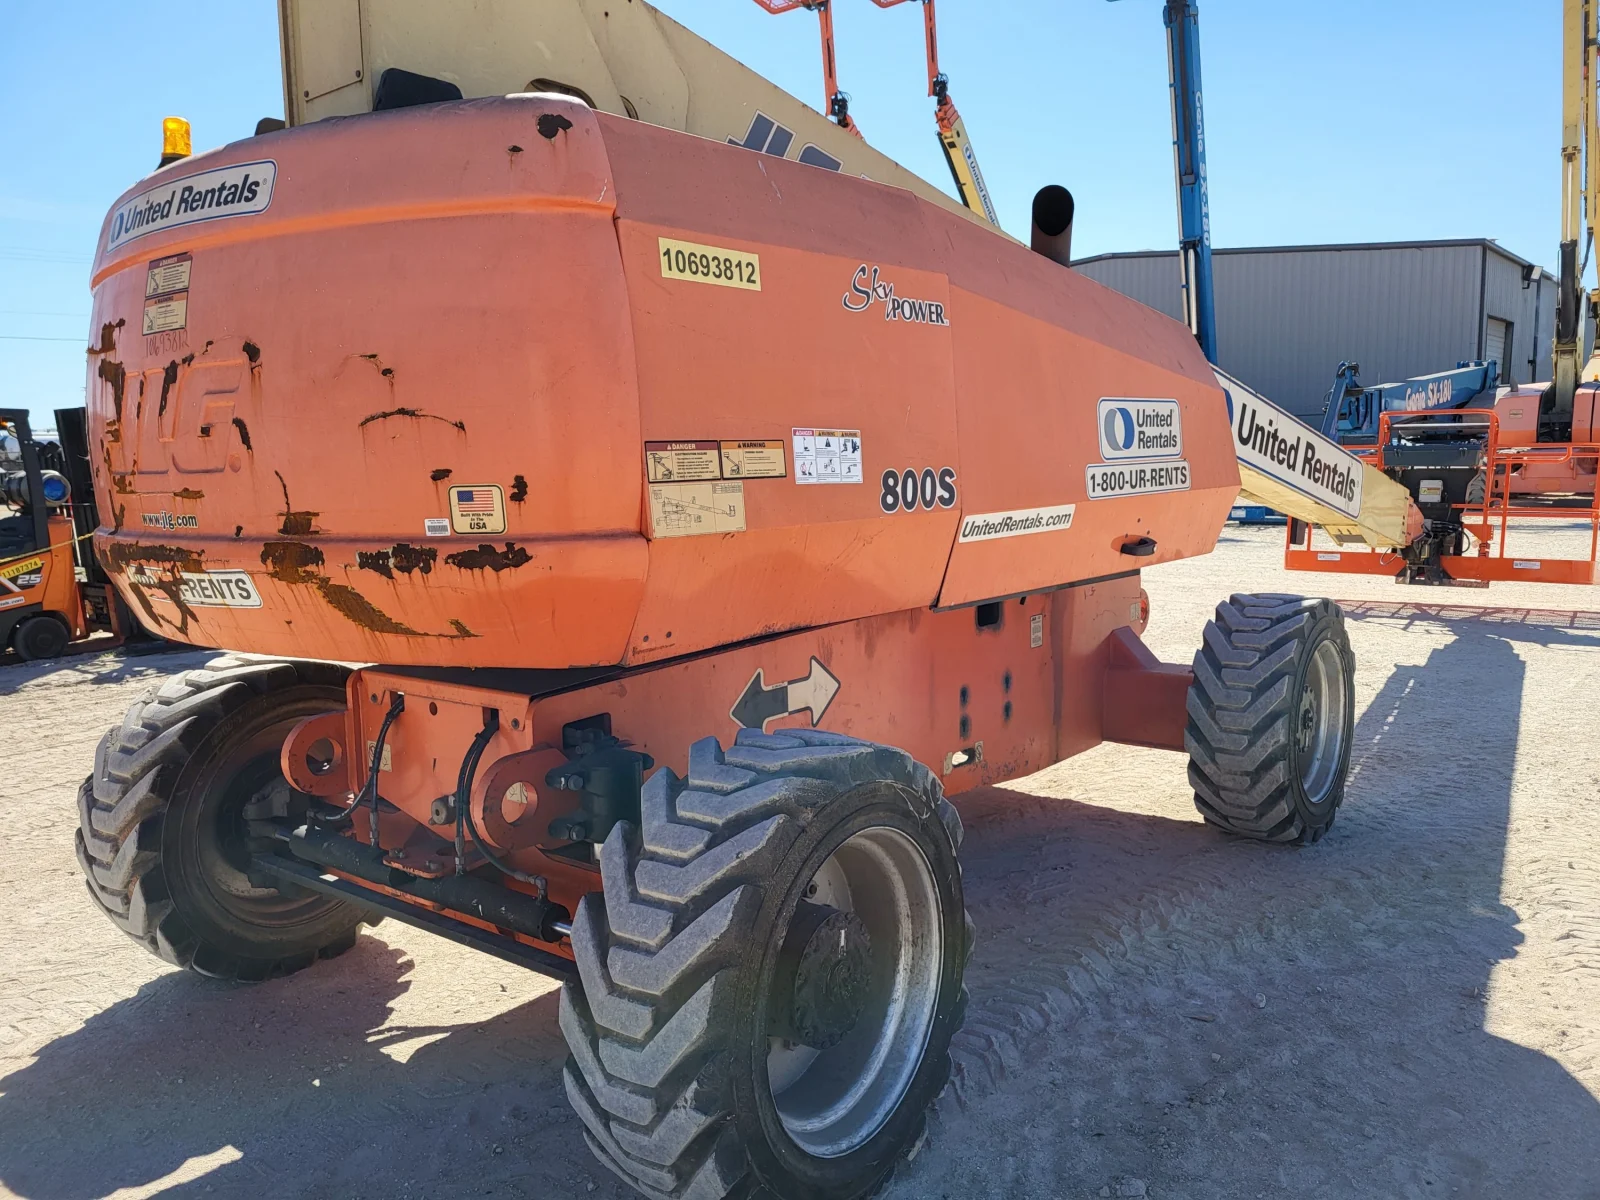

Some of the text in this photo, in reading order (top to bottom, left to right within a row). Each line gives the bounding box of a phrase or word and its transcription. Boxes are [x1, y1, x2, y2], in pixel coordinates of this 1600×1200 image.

[969, 161, 984, 192] United
[124, 173, 260, 235] United Rentals
[662, 247, 757, 285] 10693812
[842, 264, 945, 325] Sky POWER
[1427, 378, 1452, 407] SX-180
[1136, 408, 1173, 429] United
[1137, 430, 1178, 450] Rentals
[1237, 402, 1356, 502] United Rentals
[881, 466, 957, 514] 800S
[1089, 465, 1188, 493] 1-800-UR-RENTS
[141, 511, 198, 530] www.jlg.com
[469, 522, 487, 530] USA
[961, 512, 1072, 538] UnitedRentals.com
[16, 574, 43, 586] 25
